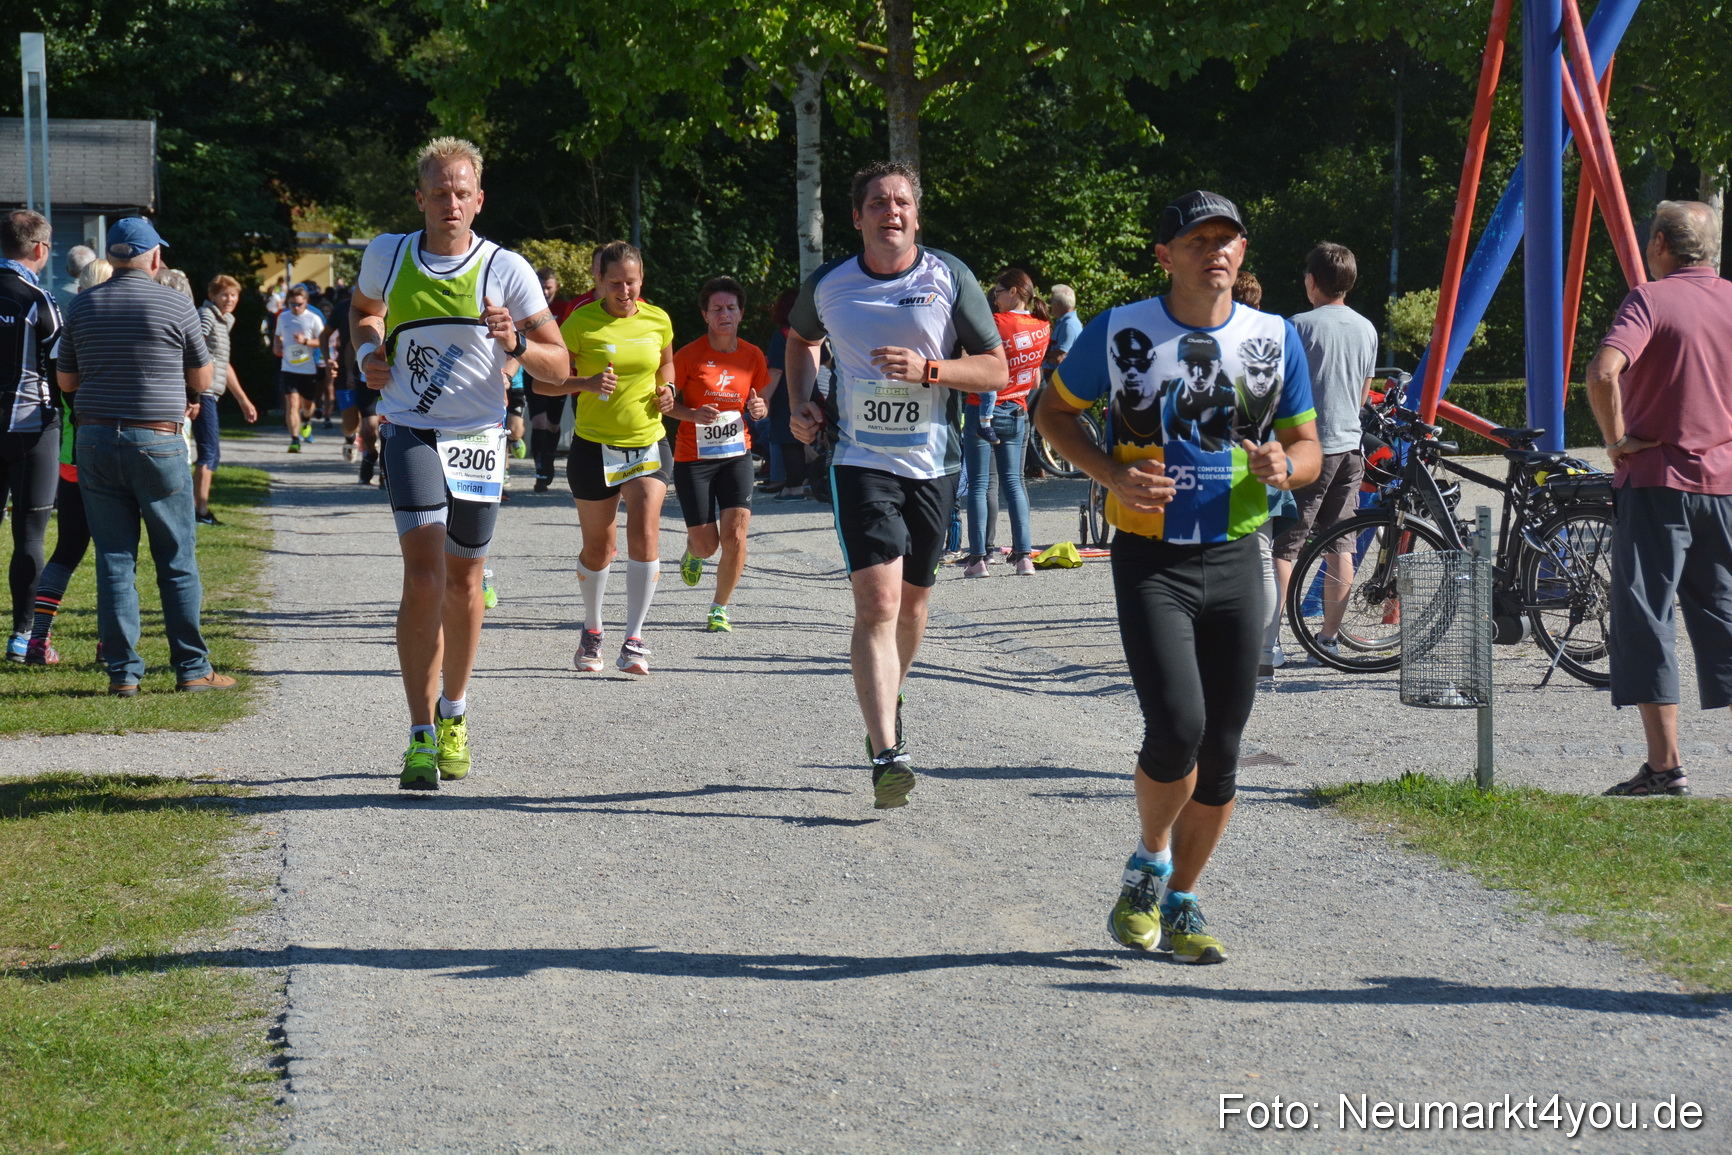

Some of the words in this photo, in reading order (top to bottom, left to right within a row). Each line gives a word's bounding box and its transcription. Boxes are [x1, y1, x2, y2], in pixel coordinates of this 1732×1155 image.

[898, 296, 926, 305] swn
[703, 389, 741, 398] funrunners
[863, 400, 920, 423] 3078
[704, 423, 738, 440] 3048
[447, 446, 496, 471] 2306
[622, 465, 645, 478] Andrea
[1197, 465, 1226, 473] COMPEXX
[456, 481, 483, 493] Florian
